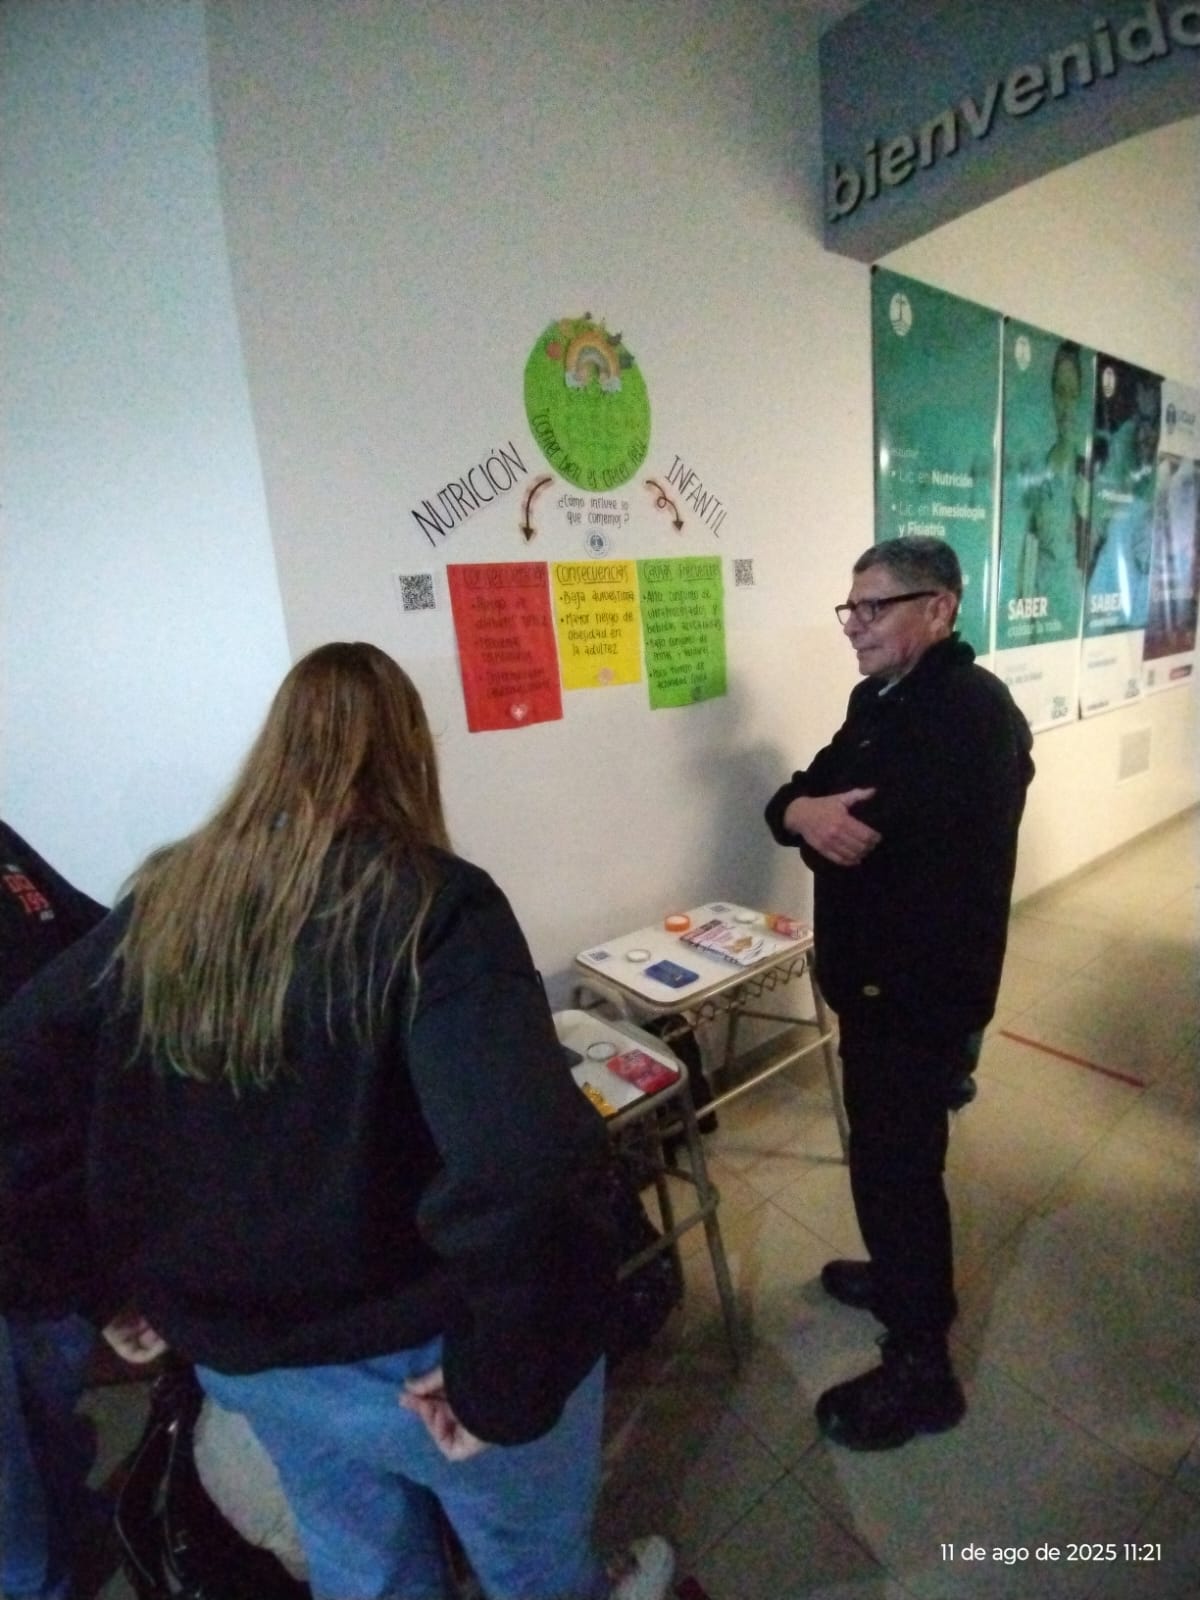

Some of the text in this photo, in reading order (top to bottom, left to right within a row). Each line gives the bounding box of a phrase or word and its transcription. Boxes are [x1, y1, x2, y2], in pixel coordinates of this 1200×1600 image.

[932, 470, 973, 488] Nutrición
[411, 440, 529, 547] NUTRICIÓN
[664, 454, 728, 538] INFANTIL
[556, 564, 629, 585] Consecuencias
[563, 590, 586, 609] Baja
[1007, 597, 1049, 620] SABER
